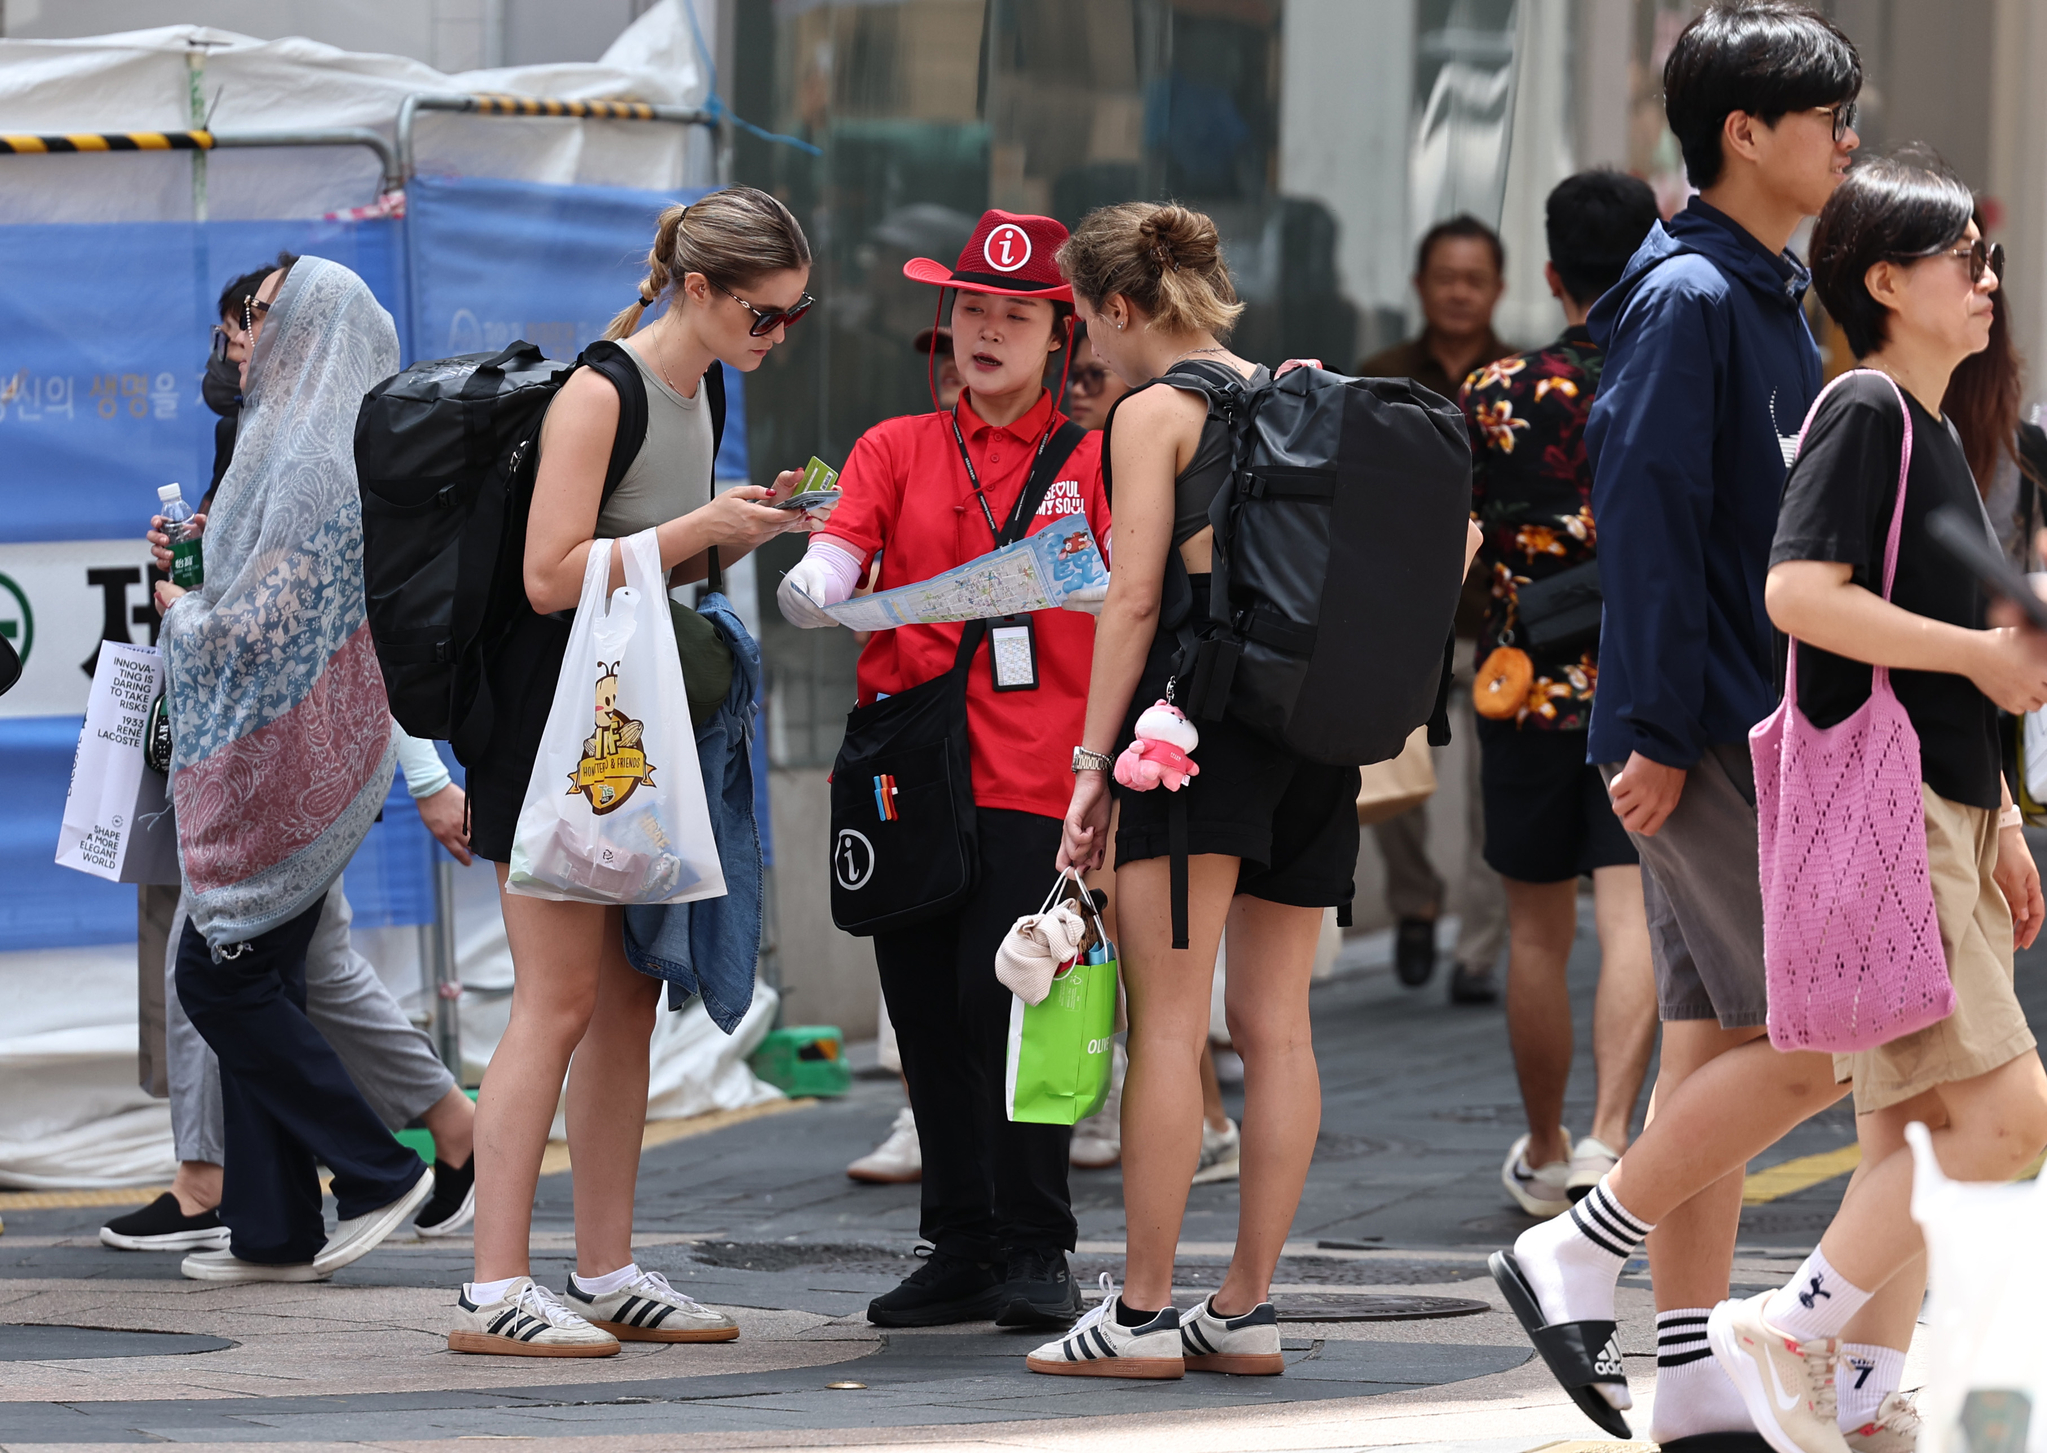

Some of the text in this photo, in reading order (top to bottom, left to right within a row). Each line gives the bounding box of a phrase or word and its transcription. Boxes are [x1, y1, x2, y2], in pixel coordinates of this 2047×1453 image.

[90, 371, 180, 420] 생명을
[1055, 498, 1086, 514] SOUL
[113, 656, 156, 674] INNOVA-
[119, 668, 154, 684] TING IS
[113, 677, 152, 693] DARING
[110, 686, 150, 703] TO TAKE
[119, 699, 148, 713] RISKS
[122, 715, 145, 728] 1933
[97, 728, 140, 748] LACOSTE
[617, 757, 641, 769] FRIENDS
[86, 833, 119, 850] A MORE
[93, 825, 121, 841] SHAPE
[79, 841, 117, 860] ELEGANT
[82, 851, 116, 870] WORLD
[1854, 1366, 1874, 1390] 7
